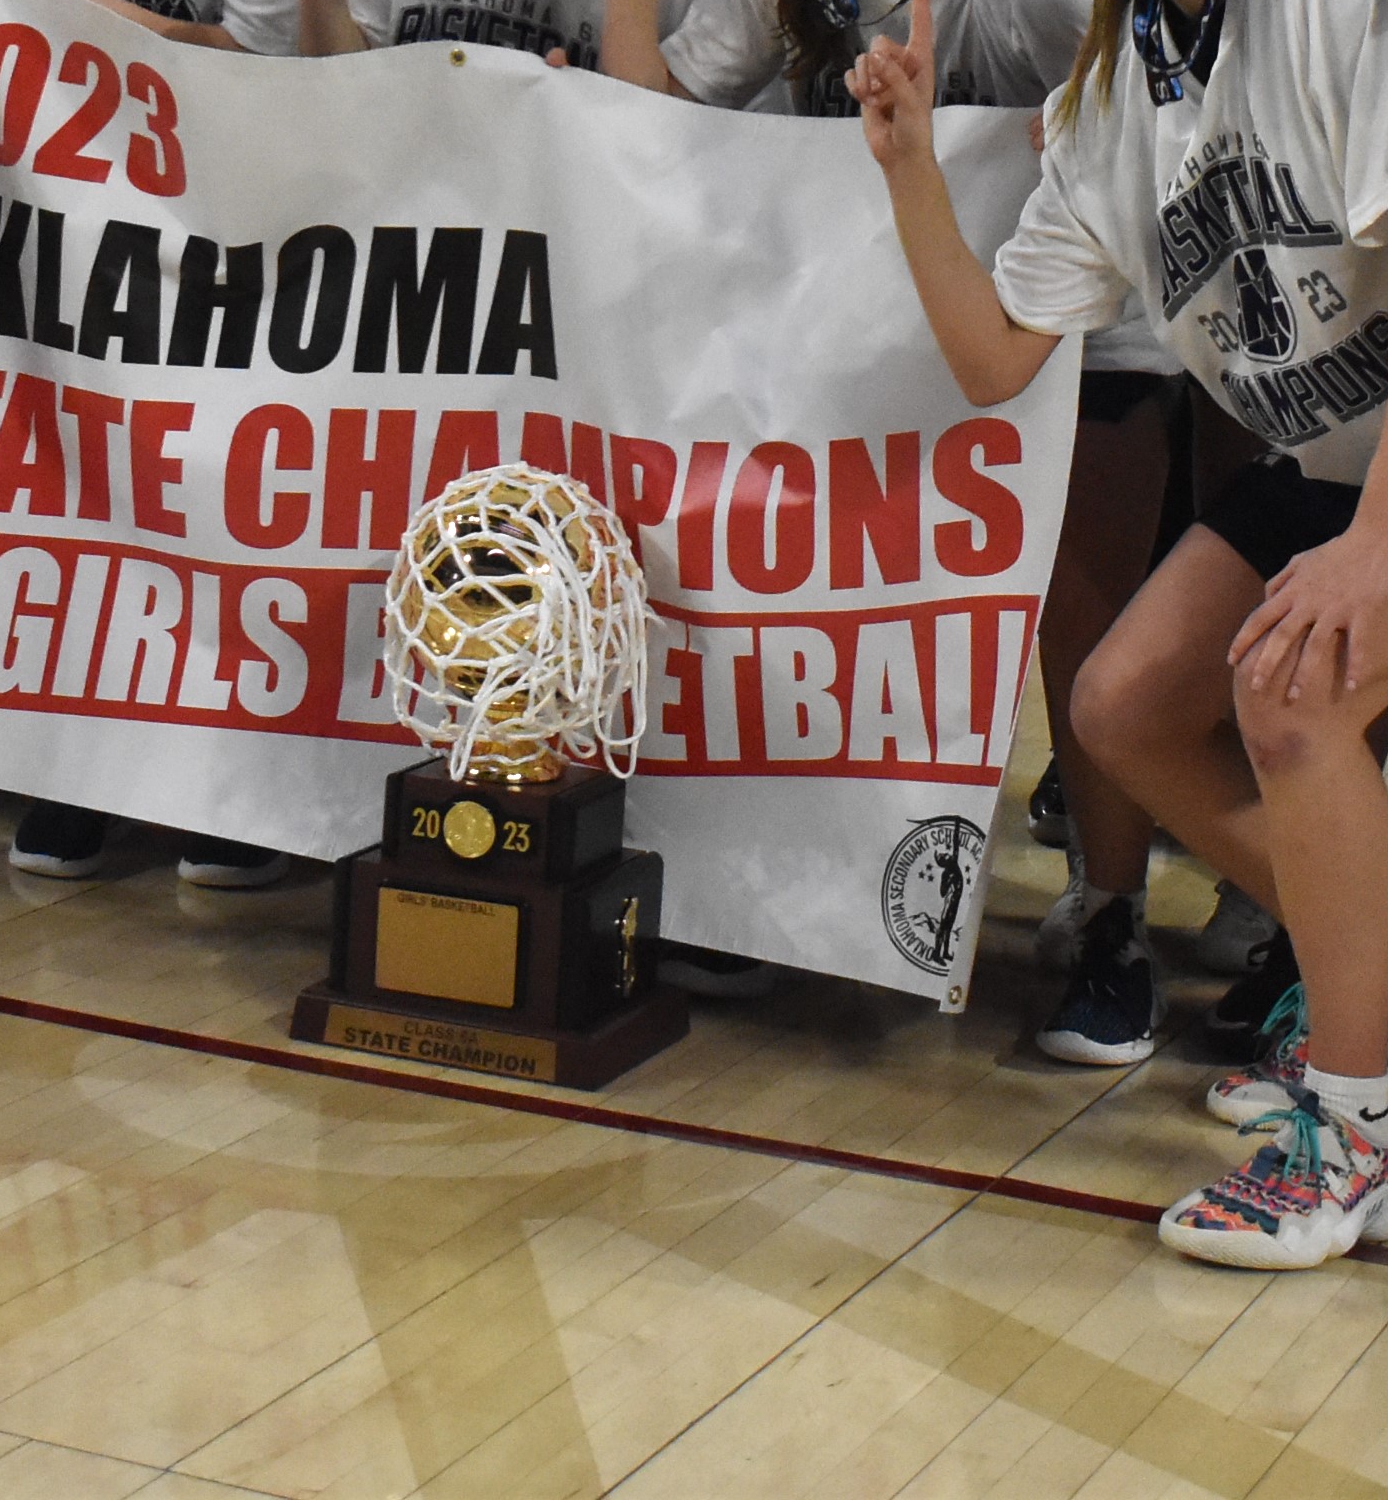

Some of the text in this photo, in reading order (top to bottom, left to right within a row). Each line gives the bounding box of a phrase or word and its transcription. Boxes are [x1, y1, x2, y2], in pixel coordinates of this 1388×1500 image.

[1297, 269, 1348, 323] 23
[412, 807, 531, 852] 20 23
[890, 834, 930, 900] SECONDARY
[431, 896, 496, 917] BASKETBALL
[344, 1027, 537, 1076] STATE CHAMPION
[404, 1021, 454, 1041] CLASS
